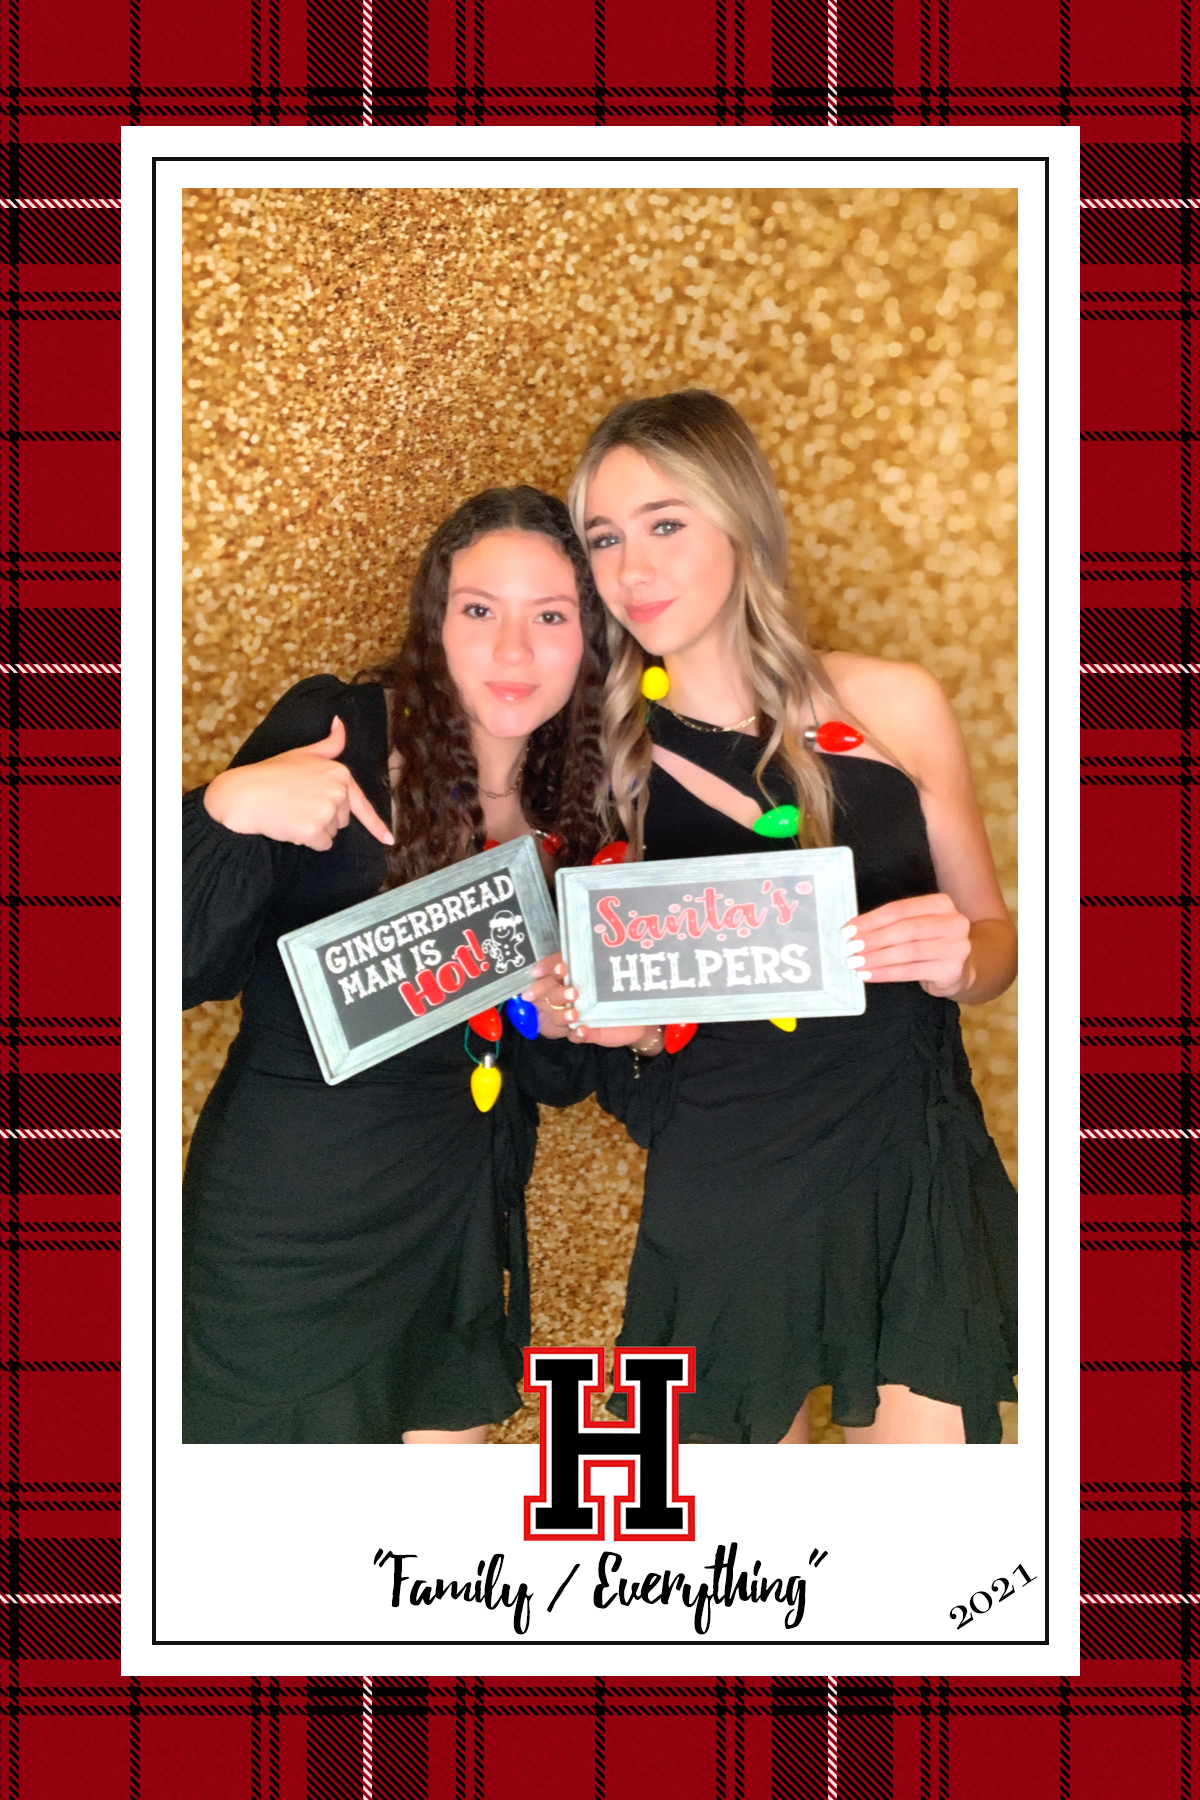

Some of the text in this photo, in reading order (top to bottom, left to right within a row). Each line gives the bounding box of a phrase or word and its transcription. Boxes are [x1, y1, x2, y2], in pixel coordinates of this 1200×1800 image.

[325, 875, 515, 974] GINGERBREAD
[596, 879, 798, 948] Santa's
[337, 938, 442, 1005] MAN IS
[609, 943, 812, 992] HELPERS
